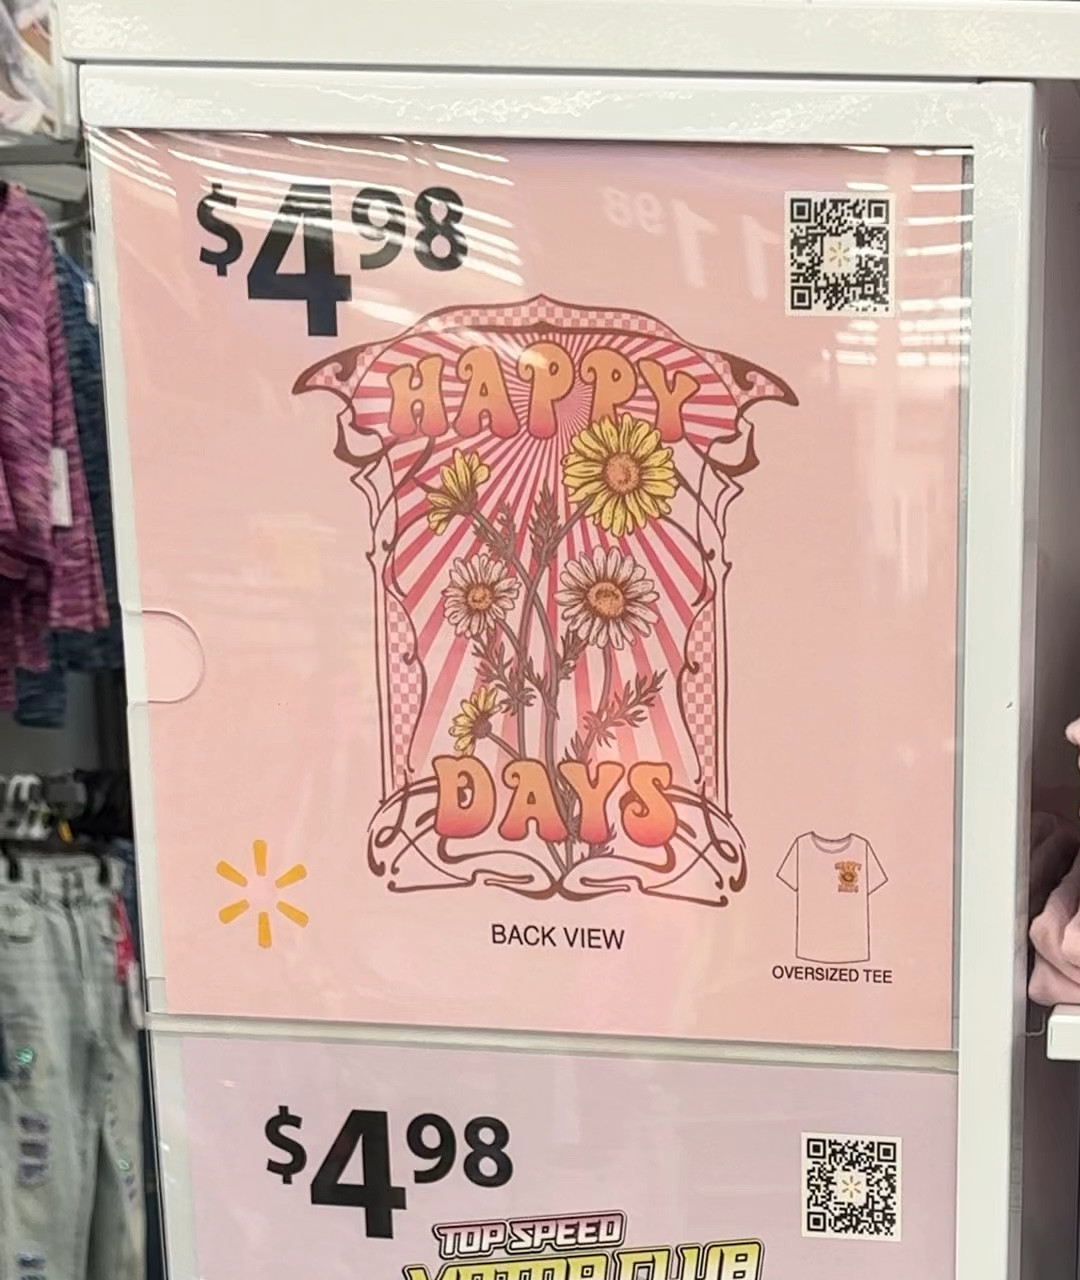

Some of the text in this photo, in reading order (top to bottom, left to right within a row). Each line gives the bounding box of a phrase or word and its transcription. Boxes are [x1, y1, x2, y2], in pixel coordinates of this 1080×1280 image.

[387, 342, 703, 443] HAPPY
[432, 755, 679, 843] DAYS
[491, 923, 626, 952] BACK VIEW
[772, 965, 893, 984] OVERSIZED TEE
[433, 1210, 627, 1257] TOP SPEED
